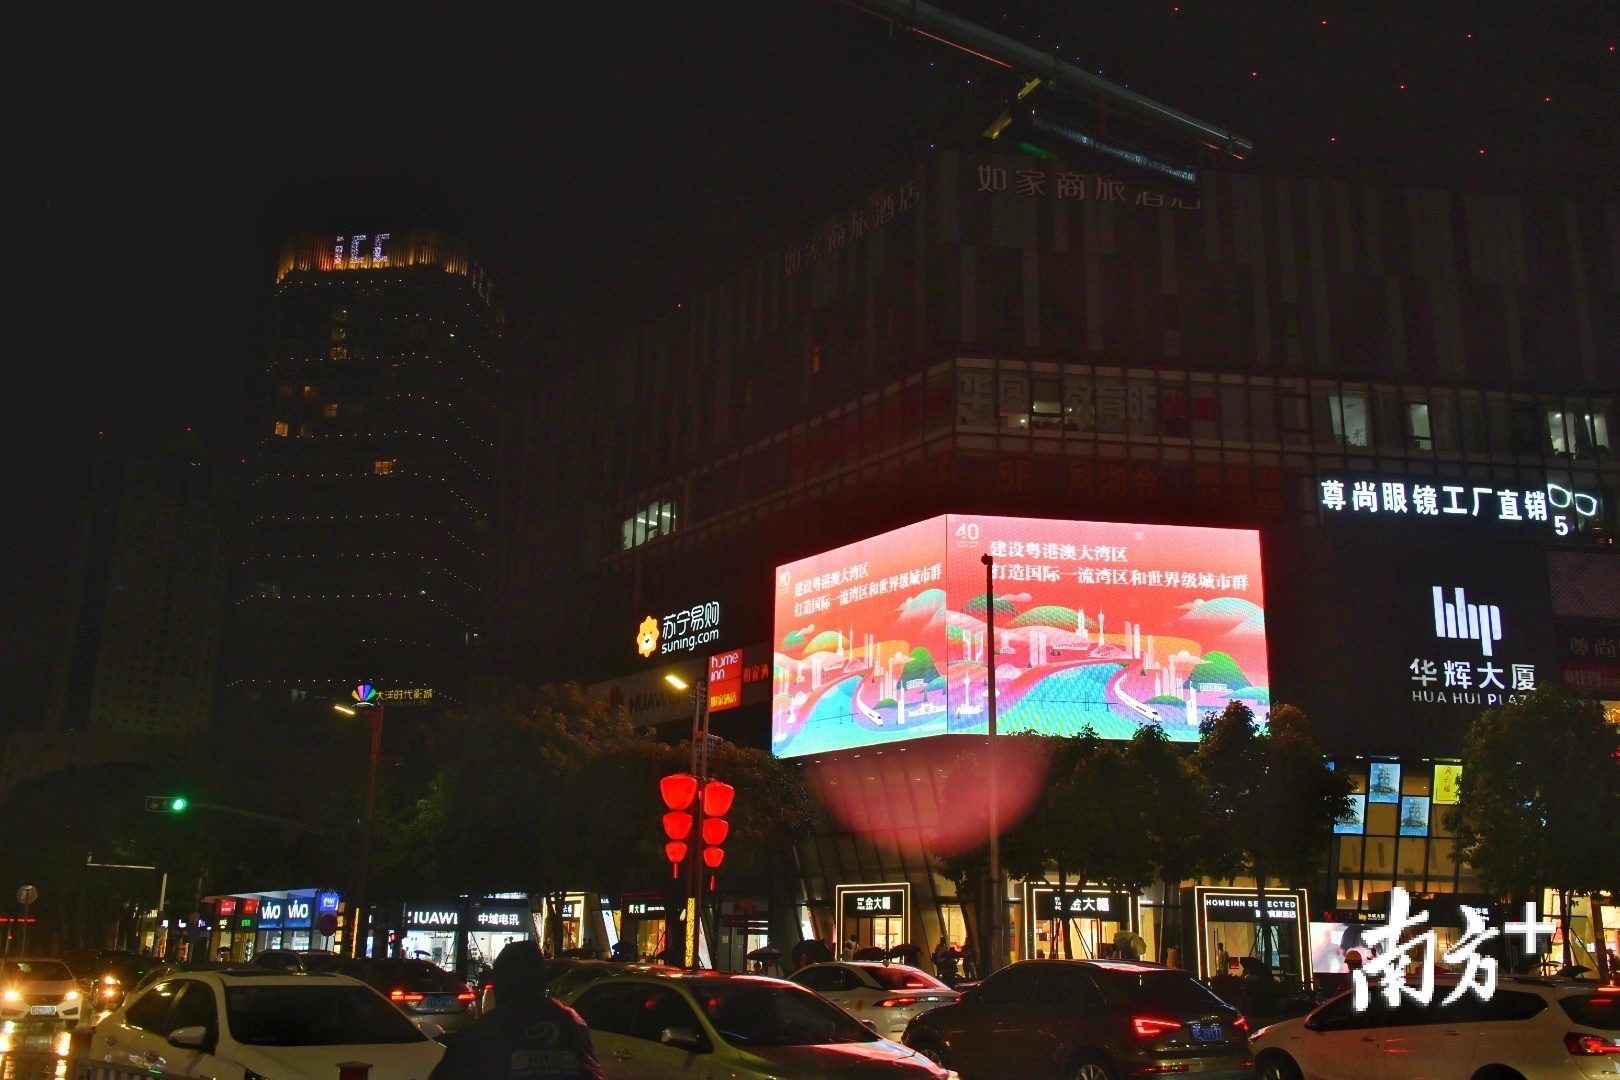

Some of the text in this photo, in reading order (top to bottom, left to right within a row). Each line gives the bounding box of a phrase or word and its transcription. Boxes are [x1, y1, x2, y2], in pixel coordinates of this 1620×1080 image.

[1321, 480, 1548, 522] 尊尚眼镜工厂直销
[955, 523, 979, 540] 40
[990, 540, 1128, 562] 建设粤港澳大湾区
[793, 563, 943, 617] 打造国际一流湾区和世界级城市群
[794, 562, 869, 597] 建设粤港澳大湾区
[992, 563, 1249, 591] 打造国际一流湾区和世界级城市群
[662, 601, 720, 641] 苏宁易购
[661, 629, 719, 655] suning.com
[1410, 658, 1537, 691] 华辉大厦
[1412, 690, 1447, 704] HUA
[1453, 692, 1481, 705] HUI
[478, 913, 519, 926] 中域电讯
